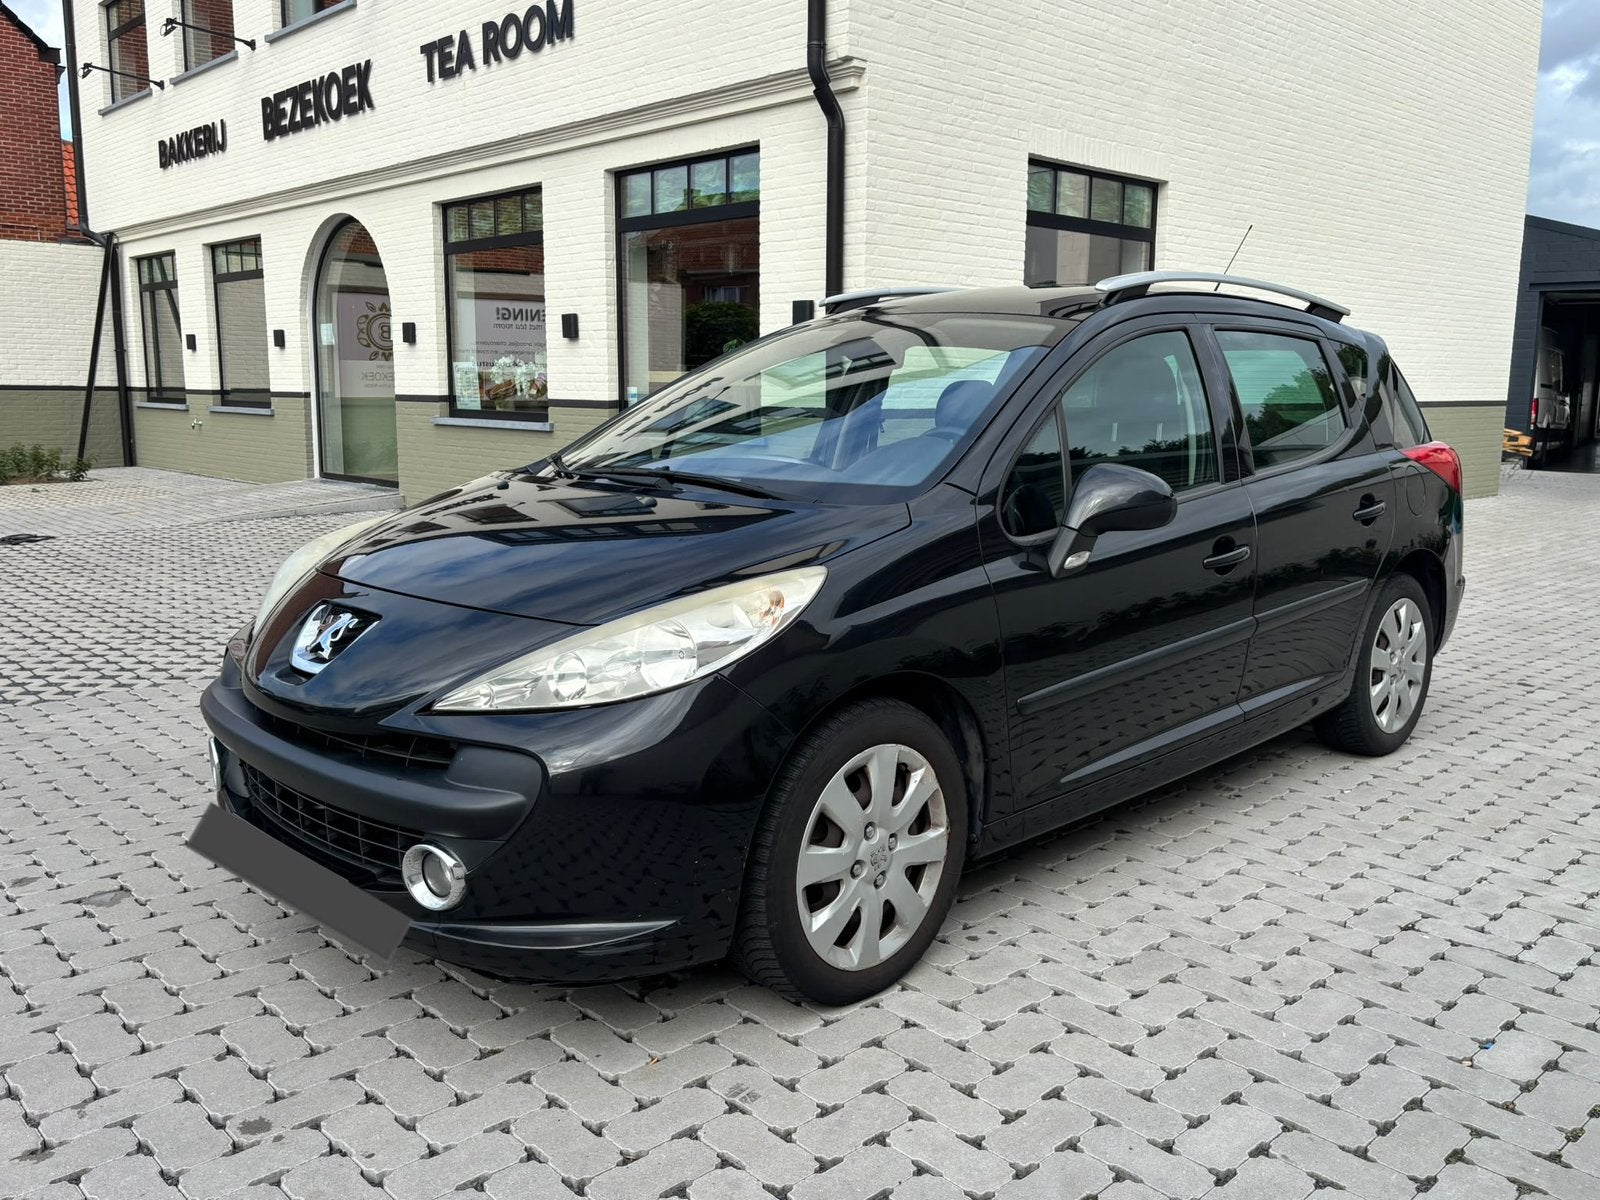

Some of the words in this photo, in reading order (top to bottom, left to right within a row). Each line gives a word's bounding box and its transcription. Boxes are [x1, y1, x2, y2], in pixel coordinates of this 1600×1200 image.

[420, 29, 475, 83] TEA
[482, 0, 575, 66] ROOM
[261, 59, 375, 142] BEZEKOEK
[158, 119, 227, 169] BAKKERIJ
